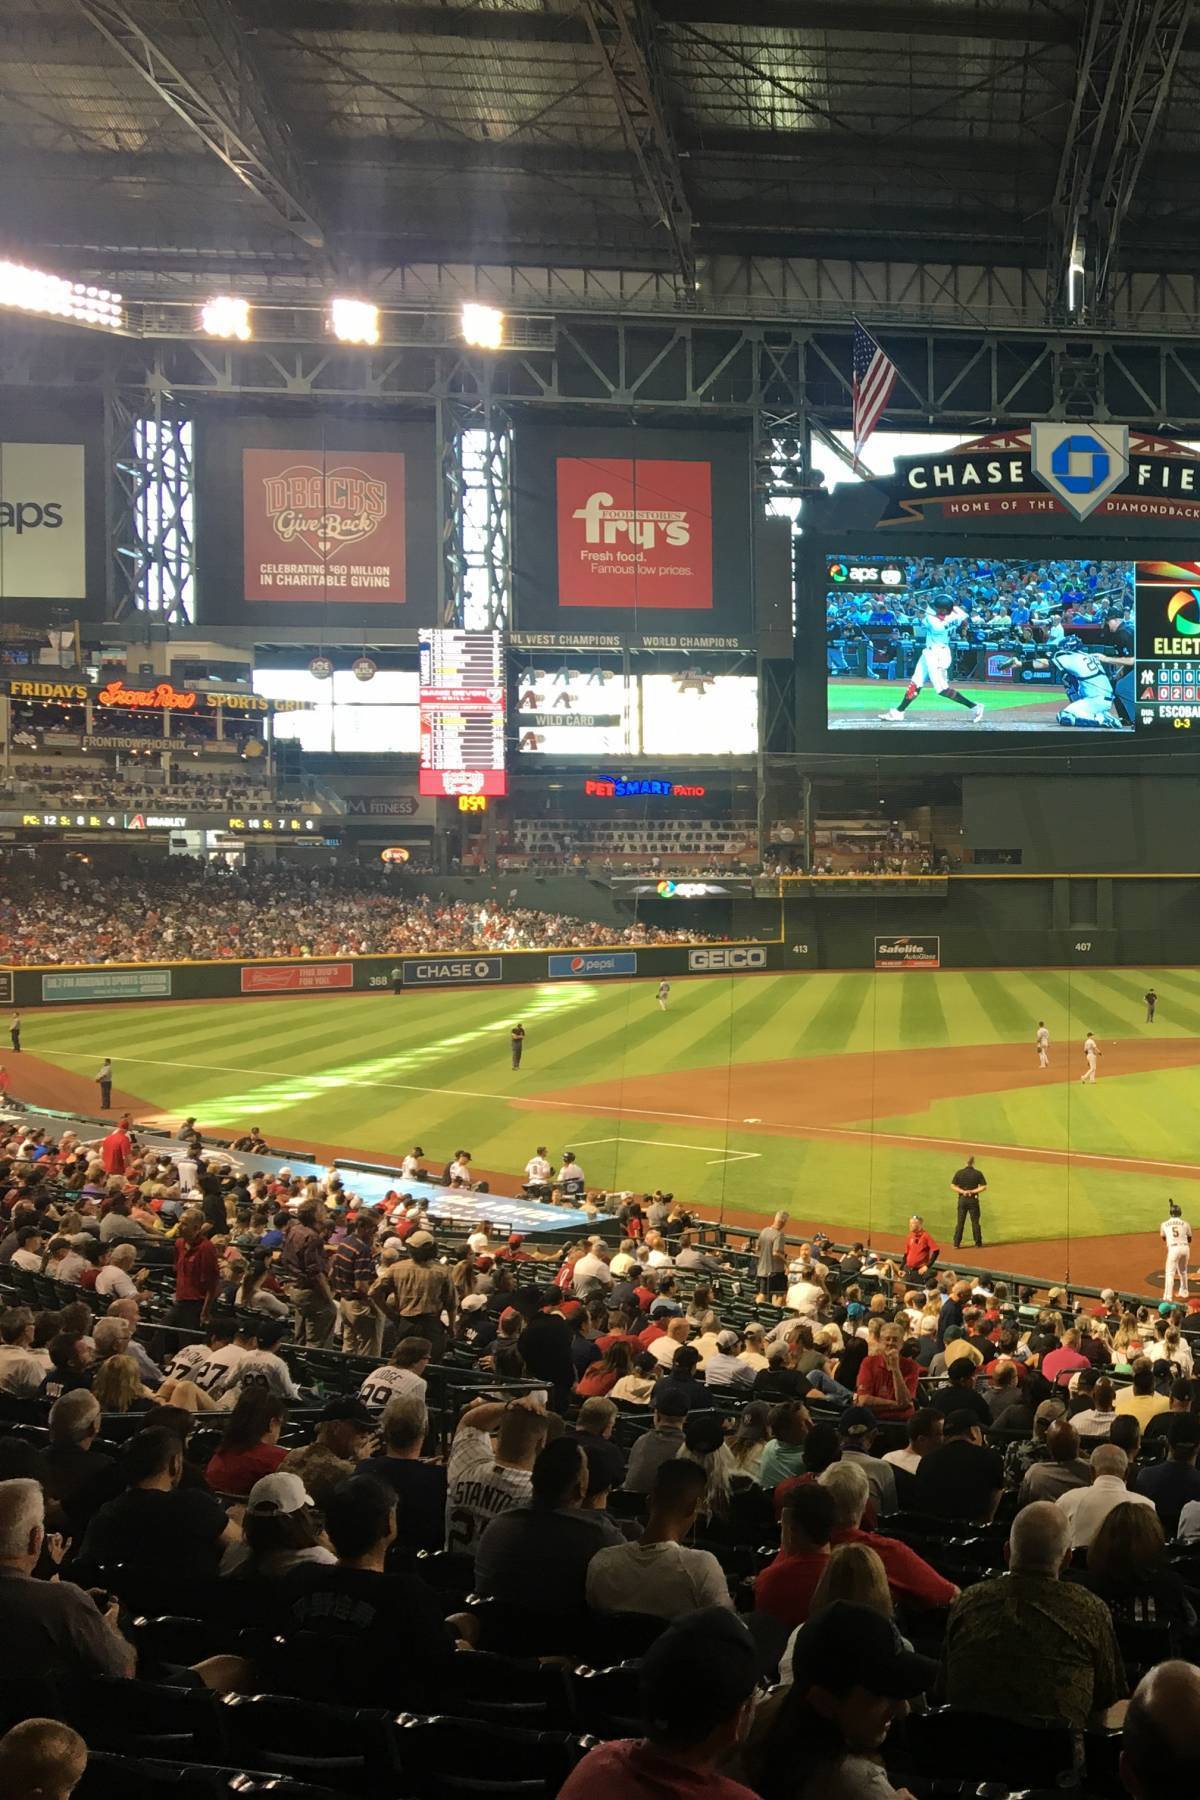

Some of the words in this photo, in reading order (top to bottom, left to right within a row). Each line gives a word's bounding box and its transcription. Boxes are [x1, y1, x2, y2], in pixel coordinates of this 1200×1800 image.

[908, 461, 1025, 490] CHASE
[951, 501, 991, 513] HOME
[1001, 501, 1018, 512] OF
[1029, 500, 1055, 511] THE
[0, 500, 63, 534] aps
[572, 491, 690, 549] fry's
[602, 510, 634, 520] FOOD
[637, 511, 682, 520] STORES
[277, 511, 320, 541] Give
[318, 511, 377, 538] Back
[580, 550, 614, 562] Fresh
[616, 550, 647, 562] food.
[260, 563, 326, 577] CELEBRATING
[328, 563, 348, 576] $60
[350, 565, 390, 576] MILLION
[591, 563, 636, 575] Famous
[638, 564, 656, 575] low
[659, 564, 695, 577] prices.
[849, 566, 879, 583] aps
[260, 574, 274, 587] IN
[276, 574, 348, 587] CHARITABLE
[350, 576, 390, 588] GIVING
[510, 635, 524, 645] NL
[526, 635, 556, 646] WEST
[559, 635, 621, 646] CHAMPIONS
[643, 636, 677, 647] WORLD
[679, 637, 739, 648] CHAMPIONS
[11, 681, 88, 699] FRIDAY'S
[99, 681, 155, 706] Front
[155, 683, 196, 709] Row
[206, 693, 269, 711] SPORTS
[1140, 708, 1154, 717] DUE
[536, 715, 563, 726] WILD
[565, 715, 595, 726] CARD
[1142, 717, 1153, 725] UP
[1173, 718, 1191, 729] 0-3
[585, 779, 674, 797] PETSMART
[673, 785, 705, 797] PATIO
[369, 804, 413, 815] FITNESS
[23, 815, 40, 825] PC:
[43, 815, 57, 826] 12
[106, 816, 116, 826] 4
[229, 819, 245, 828] PC:
[248, 819, 260, 829] 16
[278, 819, 285, 829] 7
[306, 820, 313, 830] 9
[792, 943, 808, 953] 413
[878, 944, 924, 954] Safelite
[1075, 942, 1092, 952] 407
[690, 948, 765, 969] GEICO
[903, 952, 937, 960] AutoGlass
[416, 964, 472, 979] CHASE
[586, 958, 615, 972] pepsi
[369, 976, 388, 986] 368
[1171, 1226, 1180, 1238] 5
[195, 1361, 229, 1392] 27
[455, 1481, 512, 1514] STANTO
